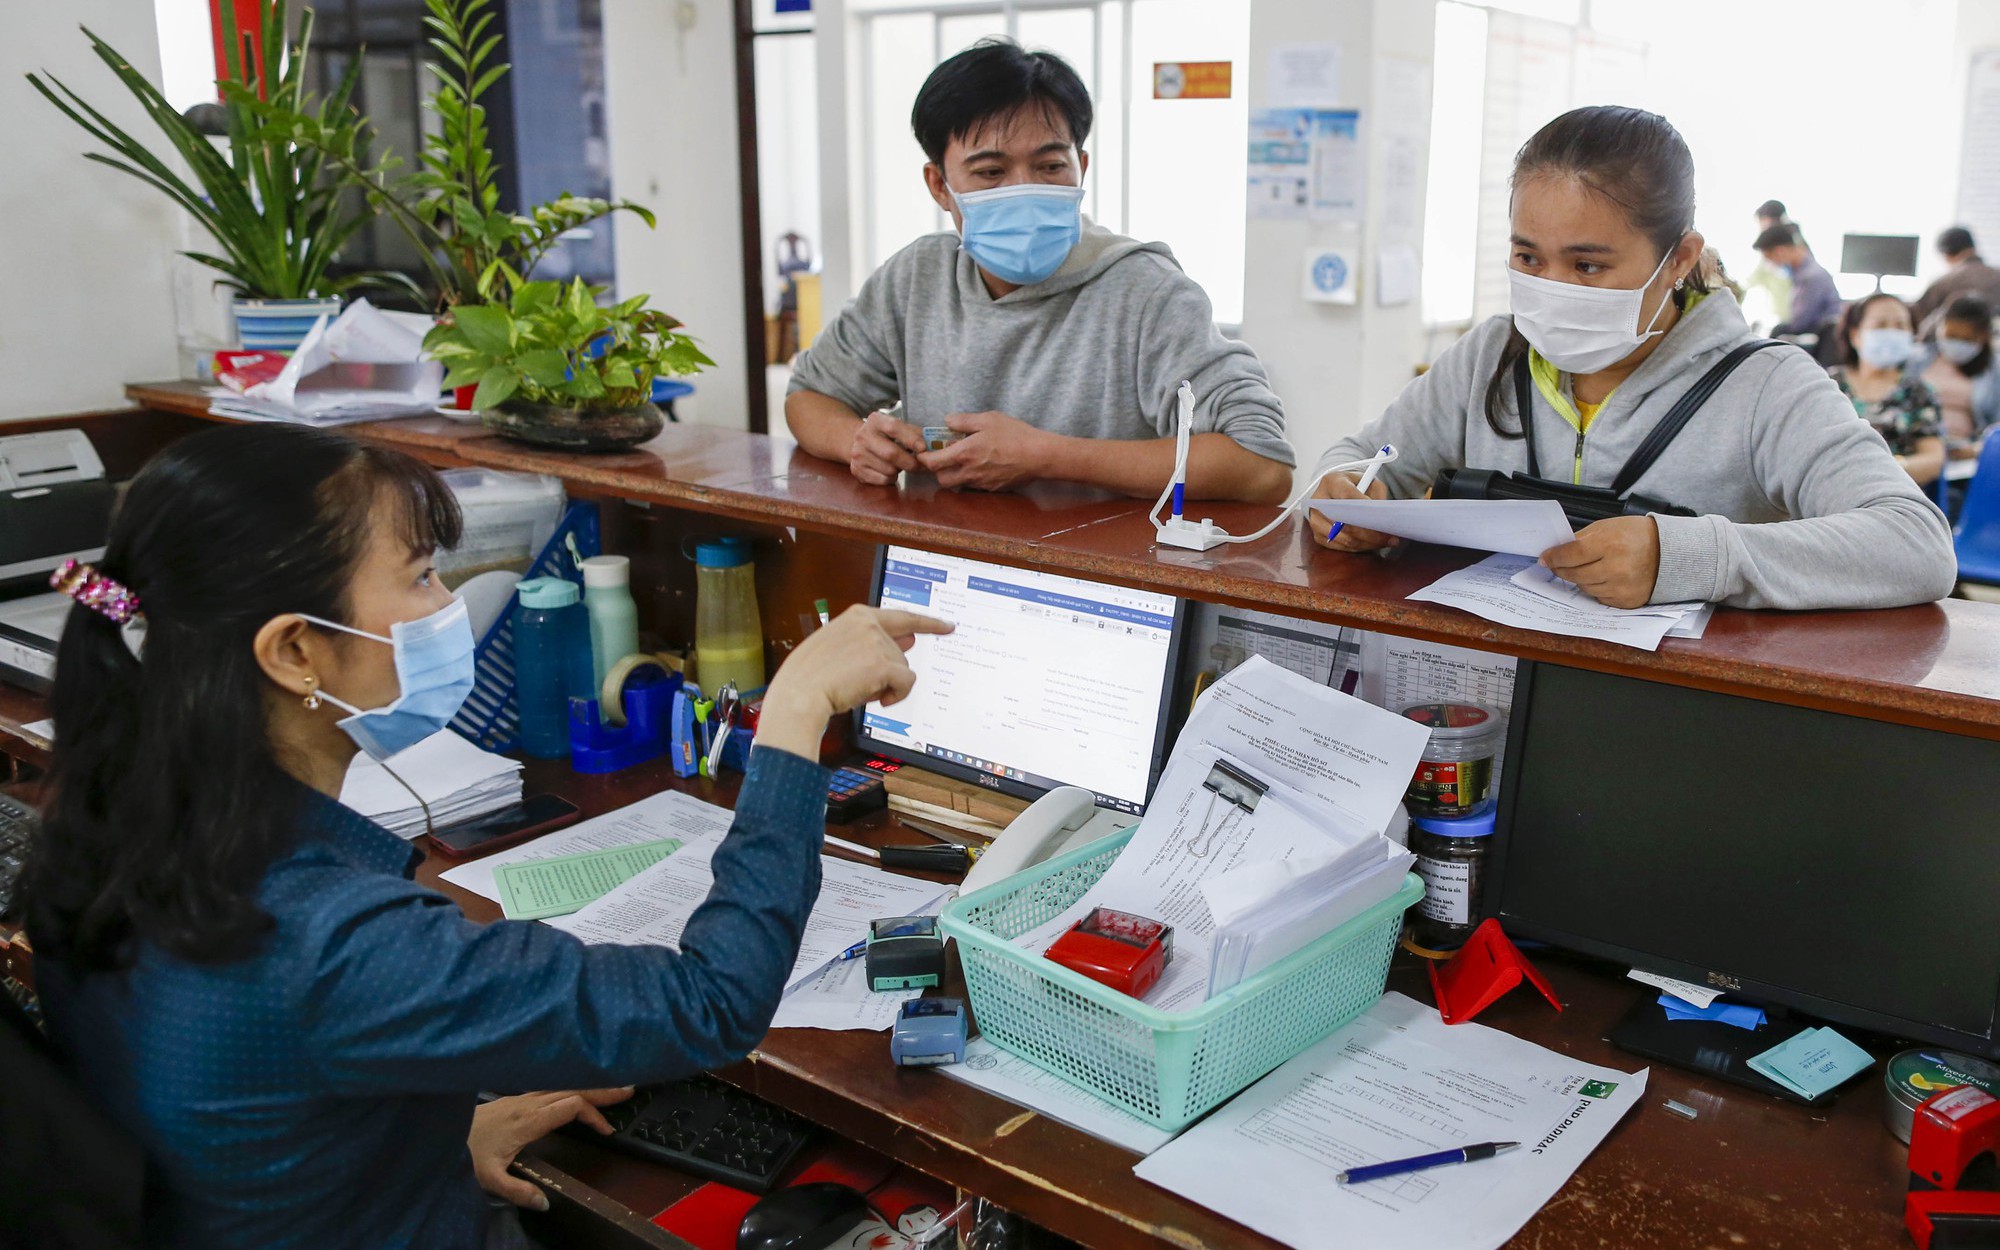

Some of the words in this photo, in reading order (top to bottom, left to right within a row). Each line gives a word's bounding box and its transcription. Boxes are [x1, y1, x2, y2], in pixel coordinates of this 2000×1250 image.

[1264, 736, 1281, 748] PHIẾU
[1280, 744, 1295, 754] GIAO
[1295, 750, 1311, 761] NHẬN
[1311, 755, 1320, 764] HỒ
[1707, 971, 1741, 990] DELL
[1570, 1075, 1585, 1087] The
[1935, 1064, 1967, 1079] Mixed
[1966, 1075, 1992, 1089] Fruit
